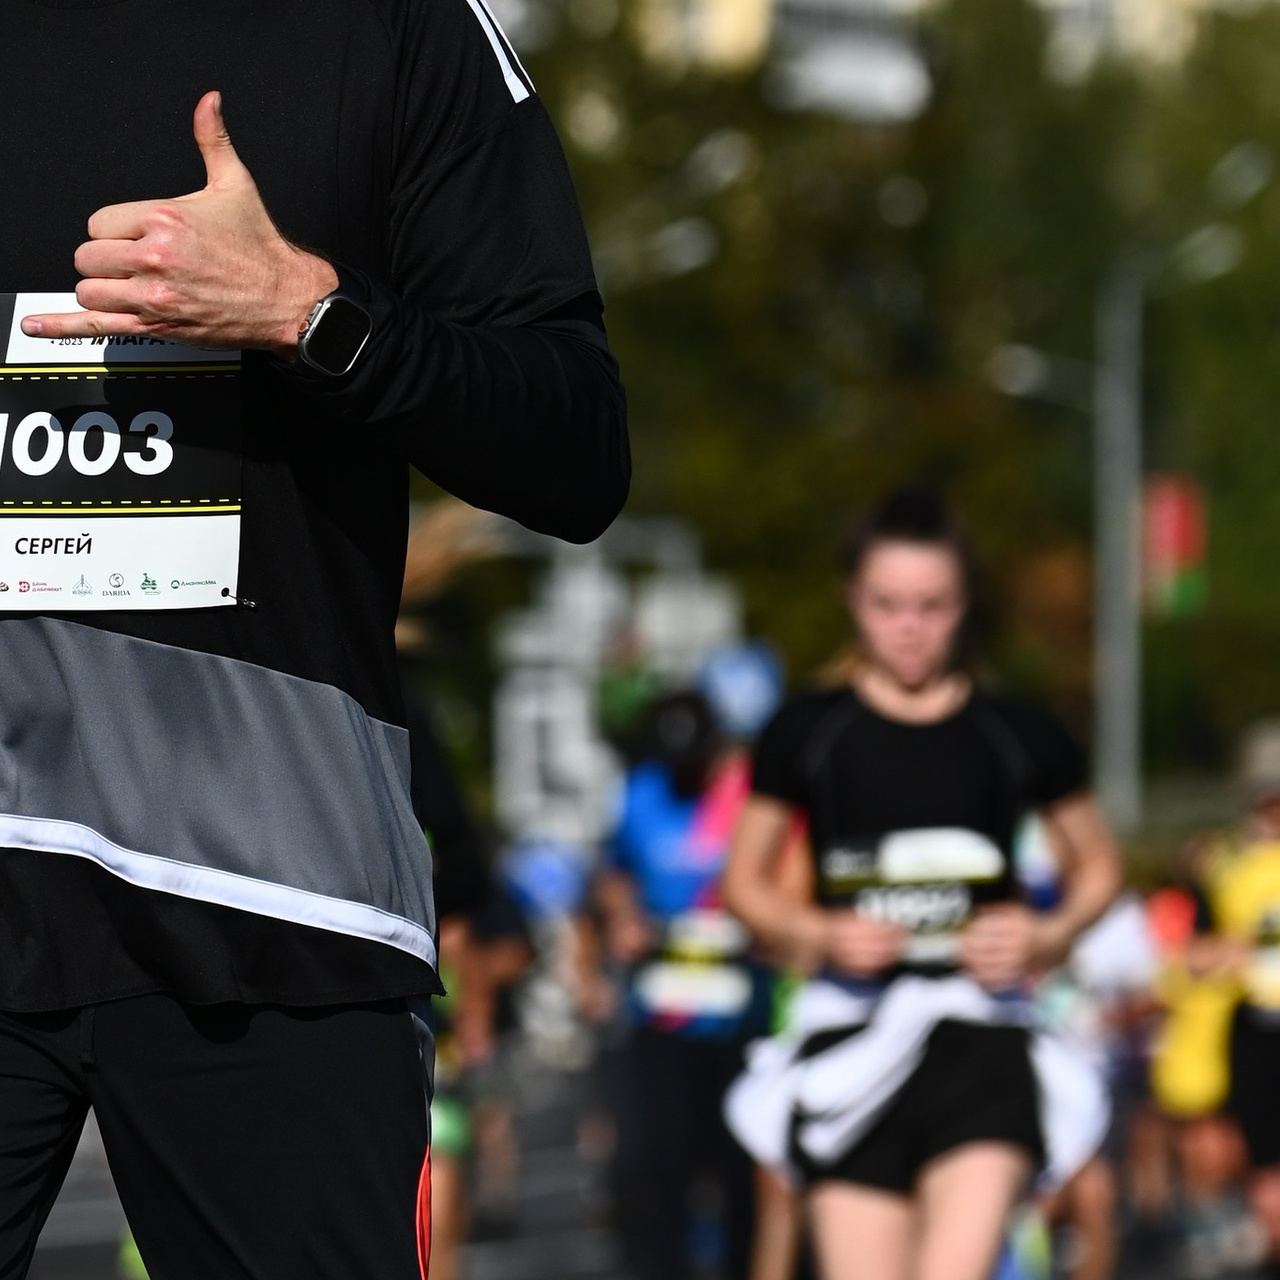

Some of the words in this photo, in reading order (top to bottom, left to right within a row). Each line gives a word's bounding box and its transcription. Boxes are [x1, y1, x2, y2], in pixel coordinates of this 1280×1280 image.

[58, 337, 83, 346] 2023
[14, 533, 93, 555] СЕРГЕЙ
[102, 589, 131, 597] DARIDA
